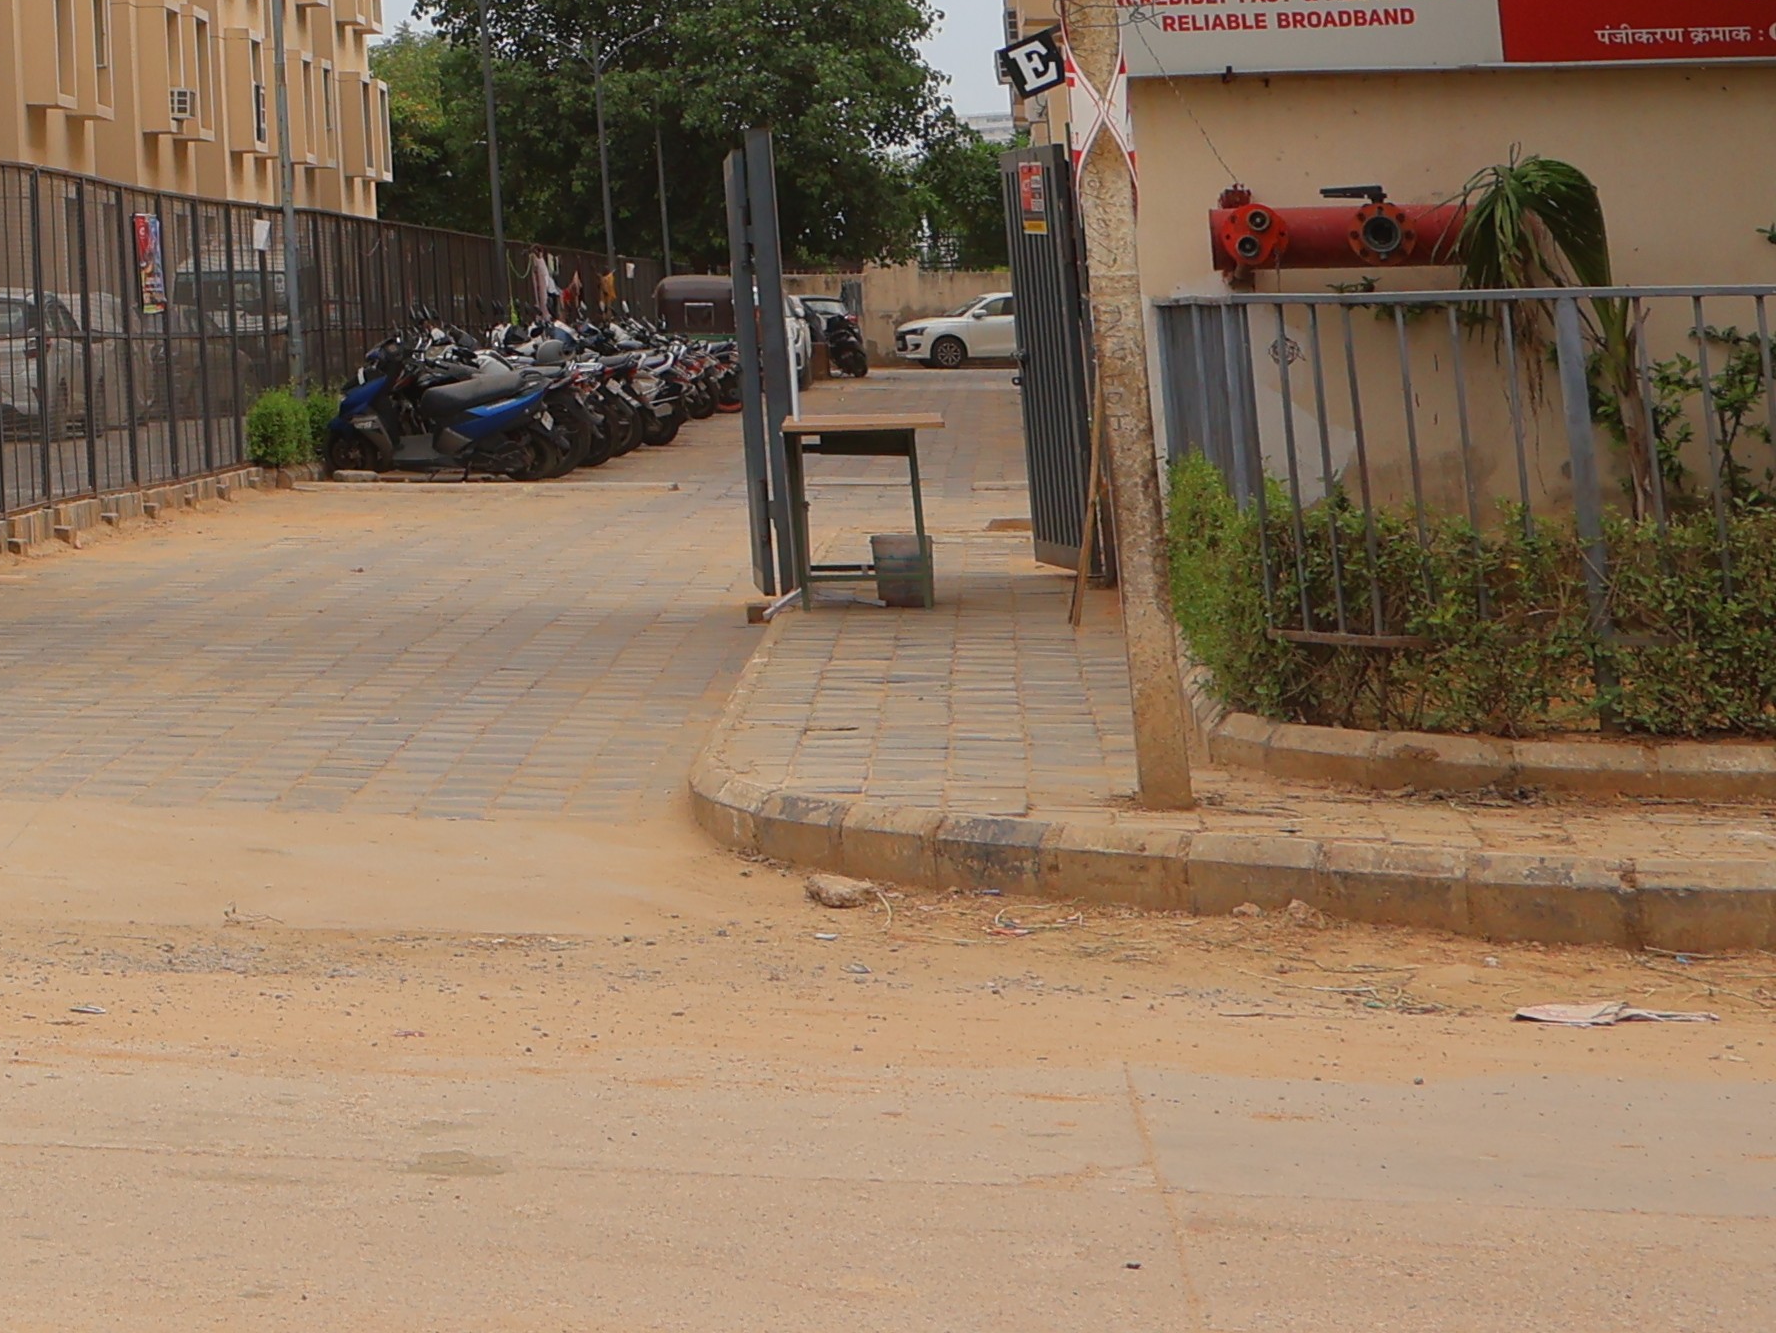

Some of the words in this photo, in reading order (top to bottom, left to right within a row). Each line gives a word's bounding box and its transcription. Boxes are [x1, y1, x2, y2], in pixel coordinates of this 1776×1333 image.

[1162, 12, 1268, 32] RELIABLE
[1276, 8, 1416, 30] BROADBAND
[1594, 24, 1685, 44] पंजीकरण
[1007, 40, 1059, 92] E
